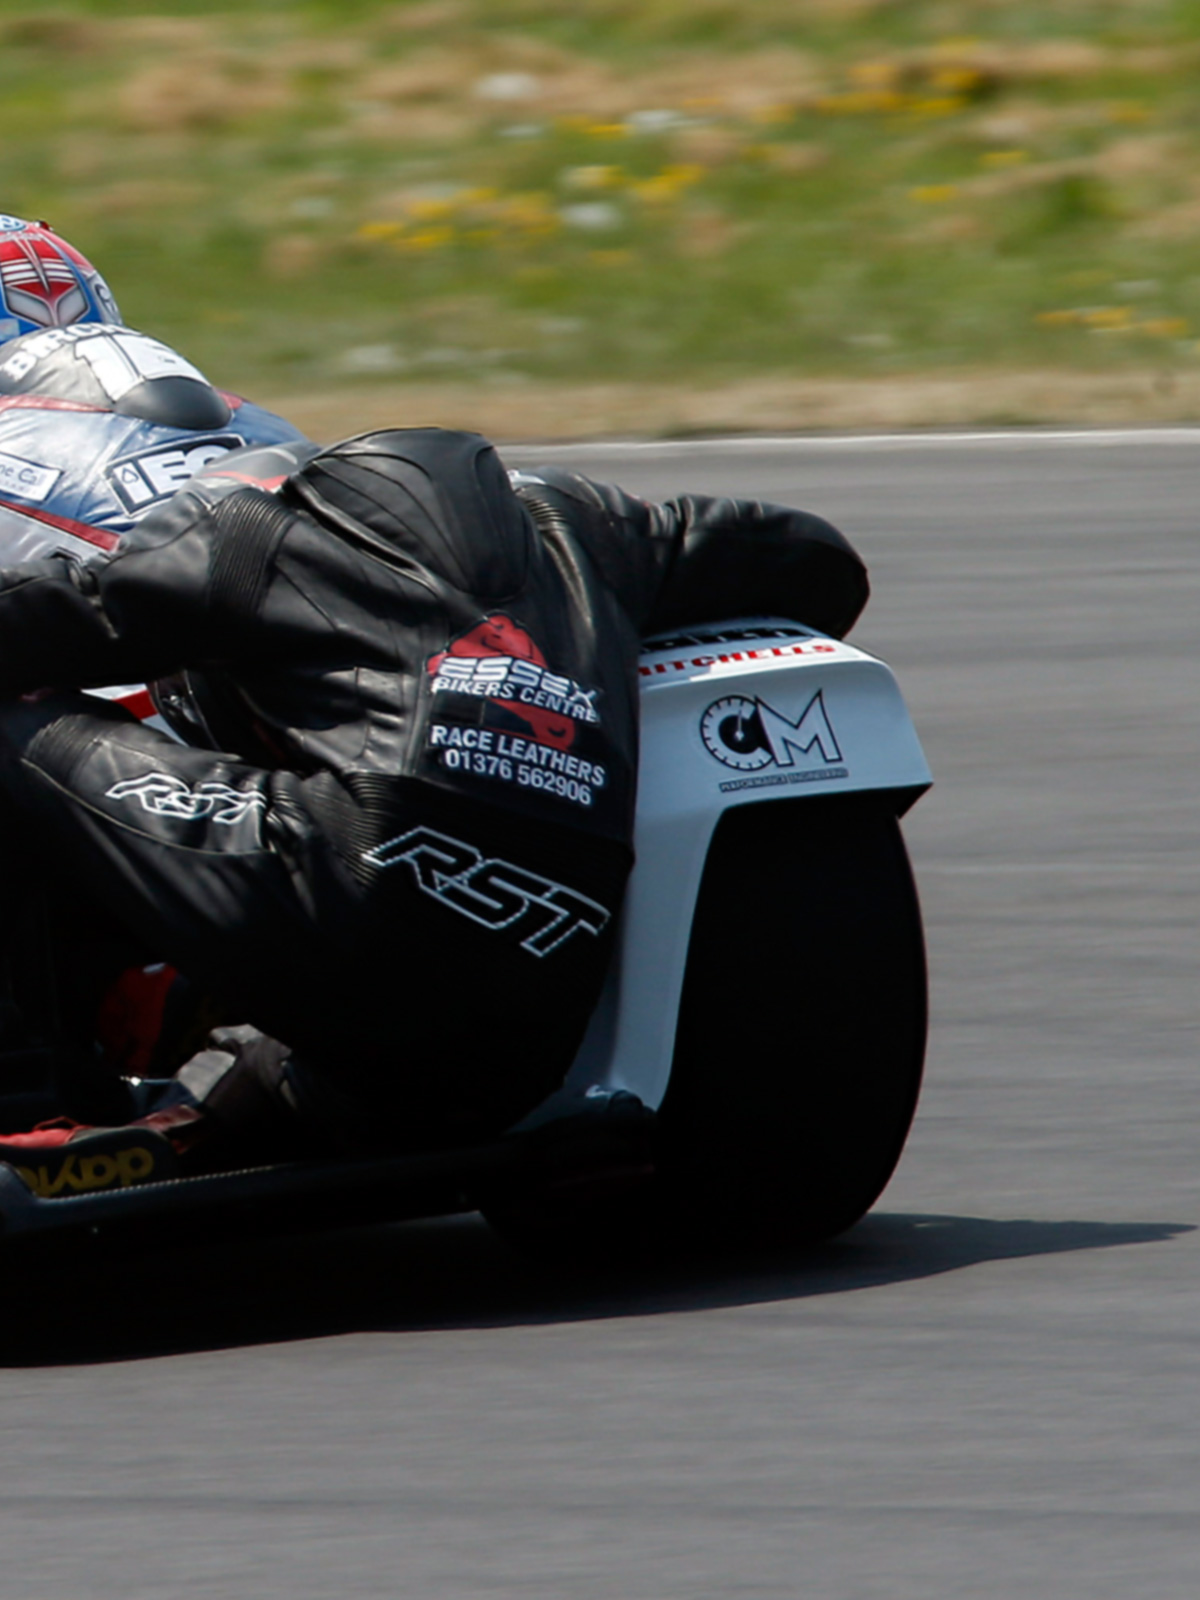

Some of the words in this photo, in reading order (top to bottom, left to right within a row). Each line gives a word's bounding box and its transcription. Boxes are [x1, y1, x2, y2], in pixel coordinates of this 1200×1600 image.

[431, 677, 516, 699] BIKERS
[520, 687, 601, 723] CENTRE
[439, 657, 597, 707] ESSEX
[430, 725, 492, 751] RACE
[497, 736, 605, 785] LEATHERS
[699, 689, 843, 771] CM
[445, 749, 513, 781] 01376
[517, 764, 592, 805] 562906
[360, 825, 612, 958] RST
